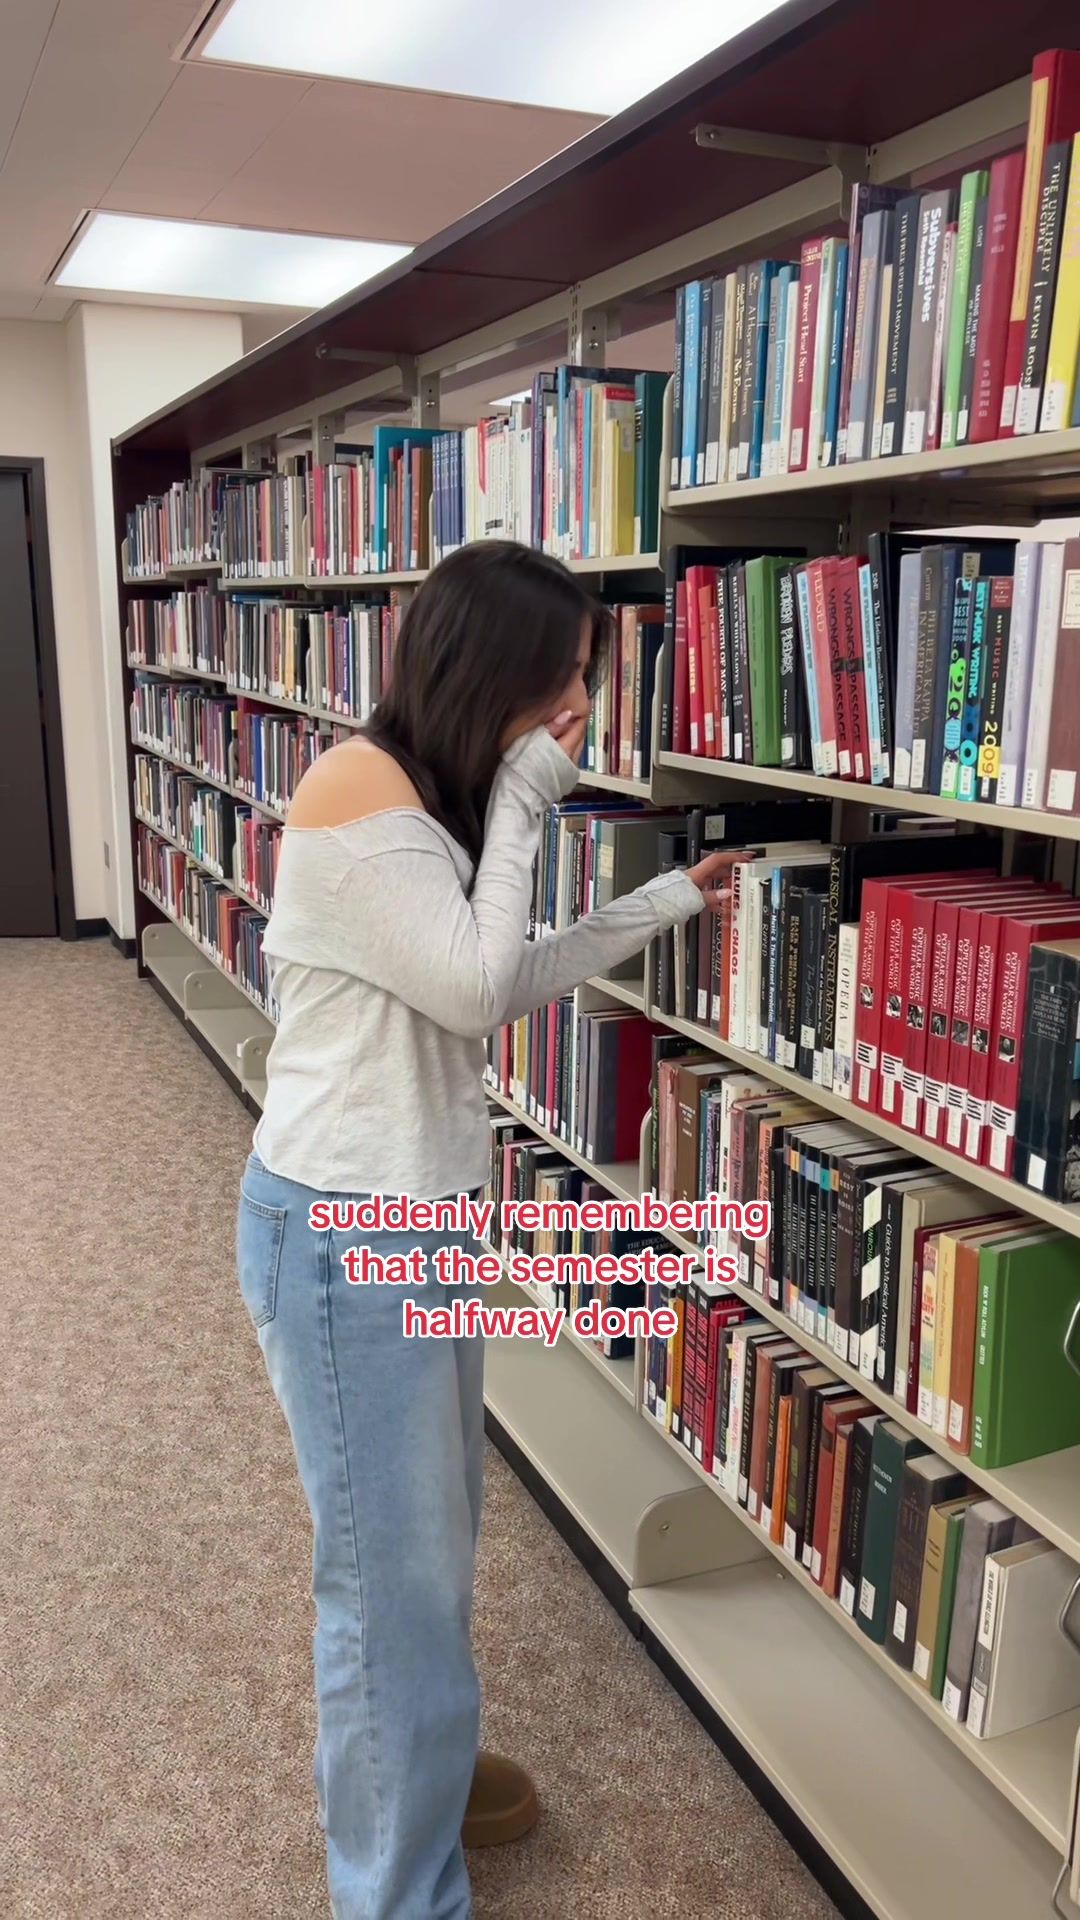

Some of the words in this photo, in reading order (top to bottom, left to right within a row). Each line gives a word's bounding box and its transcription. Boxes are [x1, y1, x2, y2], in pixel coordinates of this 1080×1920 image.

[1050, 162, 1061, 193] THE
[1036, 187, 1050, 254] DISCIPLE
[1041, 200, 1058, 274] UNLIKELY
[899, 238, 907, 265] FREE
[921, 207, 941, 322] Subversives
[802, 284, 813, 323] Project
[897, 267, 905, 308] SPEECH
[746, 315, 755, 347] Hope
[1031, 295, 1042, 340] KEVIN
[800, 326, 811, 355] Head
[892, 310, 903, 375] MOVEMENT
[798, 358, 807, 384] Start
[815, 570, 825, 632] PLEDGED
[827, 588, 839, 659] WRONGS
[844, 588, 854, 659] WRONGS
[927, 610, 936, 636] PHI
[973, 611, 984, 644] MUSIC
[914, 629, 926, 697] AMERICAN
[925, 638, 935, 675] BETA
[969, 646, 981, 698] WRITING
[992, 637, 1003, 679] MUSIC
[847, 674, 860, 744] PASSAGE
[922, 679, 932, 722] KAPPA
[733, 866, 741, 910] BLUES
[829, 856, 840, 927] MUSICAL
[732, 927, 740, 976] CHAOS
[894, 918, 902, 957] POPULAR
[916, 926, 924, 968] POPULAR
[940, 932, 948, 975] POPULAR
[862, 946, 870, 980] WORLD
[892, 959, 900, 990] MUSIC
[961, 938, 970, 983] POPULAR
[981, 944, 992, 990] POPULAR
[1008, 951, 1019, 997] POPULAR
[825, 933, 837, 1043] INSTRUMENTS
[840, 968, 850, 1022] OPERA
[909, 964, 917, 1000] WORLD
[914, 969, 923, 1002] MUSIC
[937, 977, 946, 1010] MUSIC
[954, 978, 962, 1014] WORLD
[958, 985, 968, 1016] MUSIC
[974, 985, 983, 1022] WORLD
[979, 992, 988, 1024] MUSIC
[1000, 993, 1010, 1030] WORLD
[1003, 999, 1014, 1033] MUSIC
[881, 1270, 890, 1308] Musical
[745, 1349, 753, 1389] JAZZ
